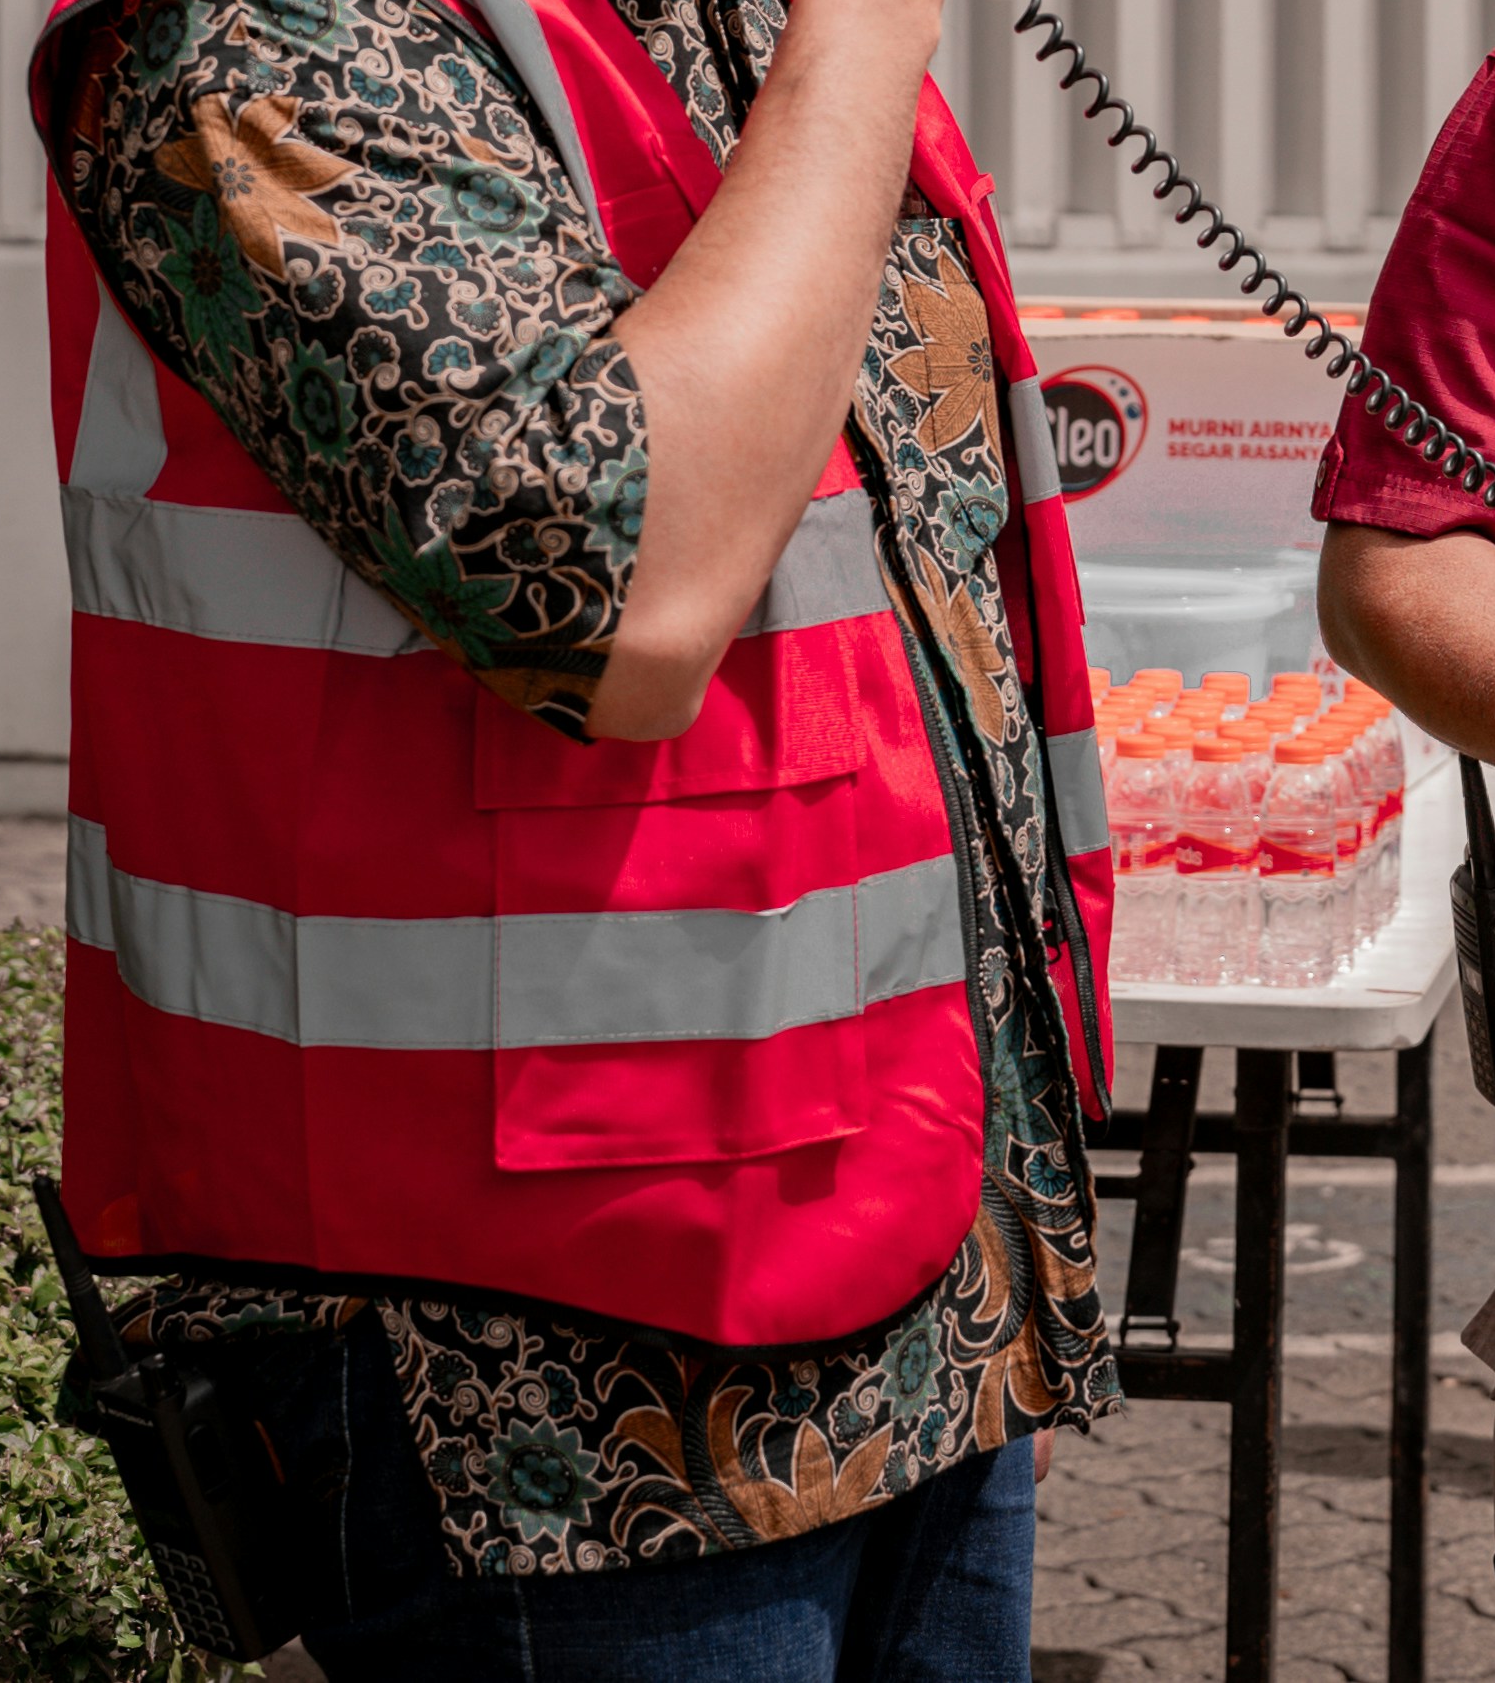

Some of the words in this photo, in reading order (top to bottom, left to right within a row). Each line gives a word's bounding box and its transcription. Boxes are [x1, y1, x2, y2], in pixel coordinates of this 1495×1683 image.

[1045, 405, 1121, 468] leo
[1168, 418, 1244, 439] MURNI
[1168, 441, 1233, 460] SEGAR
[1239, 443, 1322, 462] RASANY
